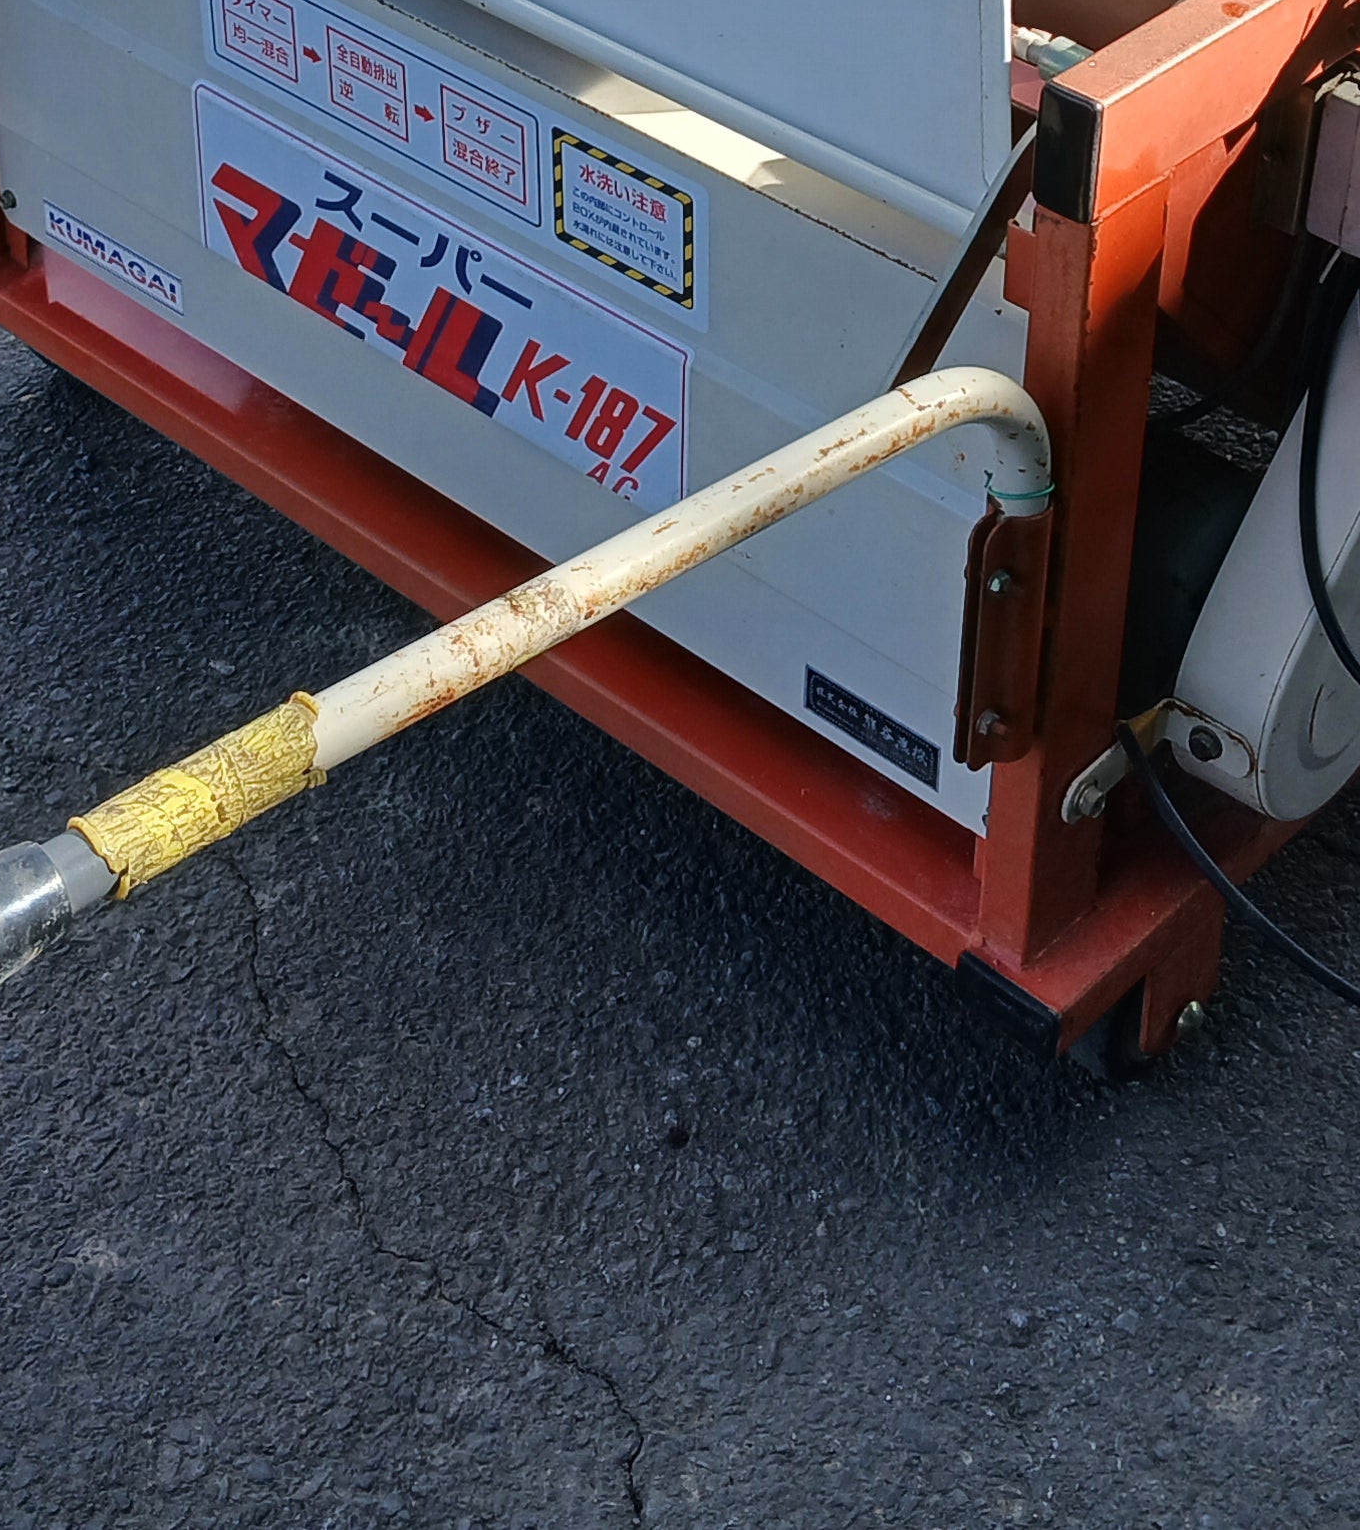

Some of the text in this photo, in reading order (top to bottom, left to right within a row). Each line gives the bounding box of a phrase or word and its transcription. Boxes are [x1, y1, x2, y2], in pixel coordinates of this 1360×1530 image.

[232, 22, 290, 67] 均一混合
[336, 44, 398, 90] 全自動排出
[451, 103, 516, 145] ブザー
[452, 138, 518, 186] 混合終了
[578, 163, 668, 224] 水洗い注意
[48, 211, 177, 304] KUMAGAI
[315, 169, 534, 310] スーパー
[211, 162, 678, 474] マゼール K-187
